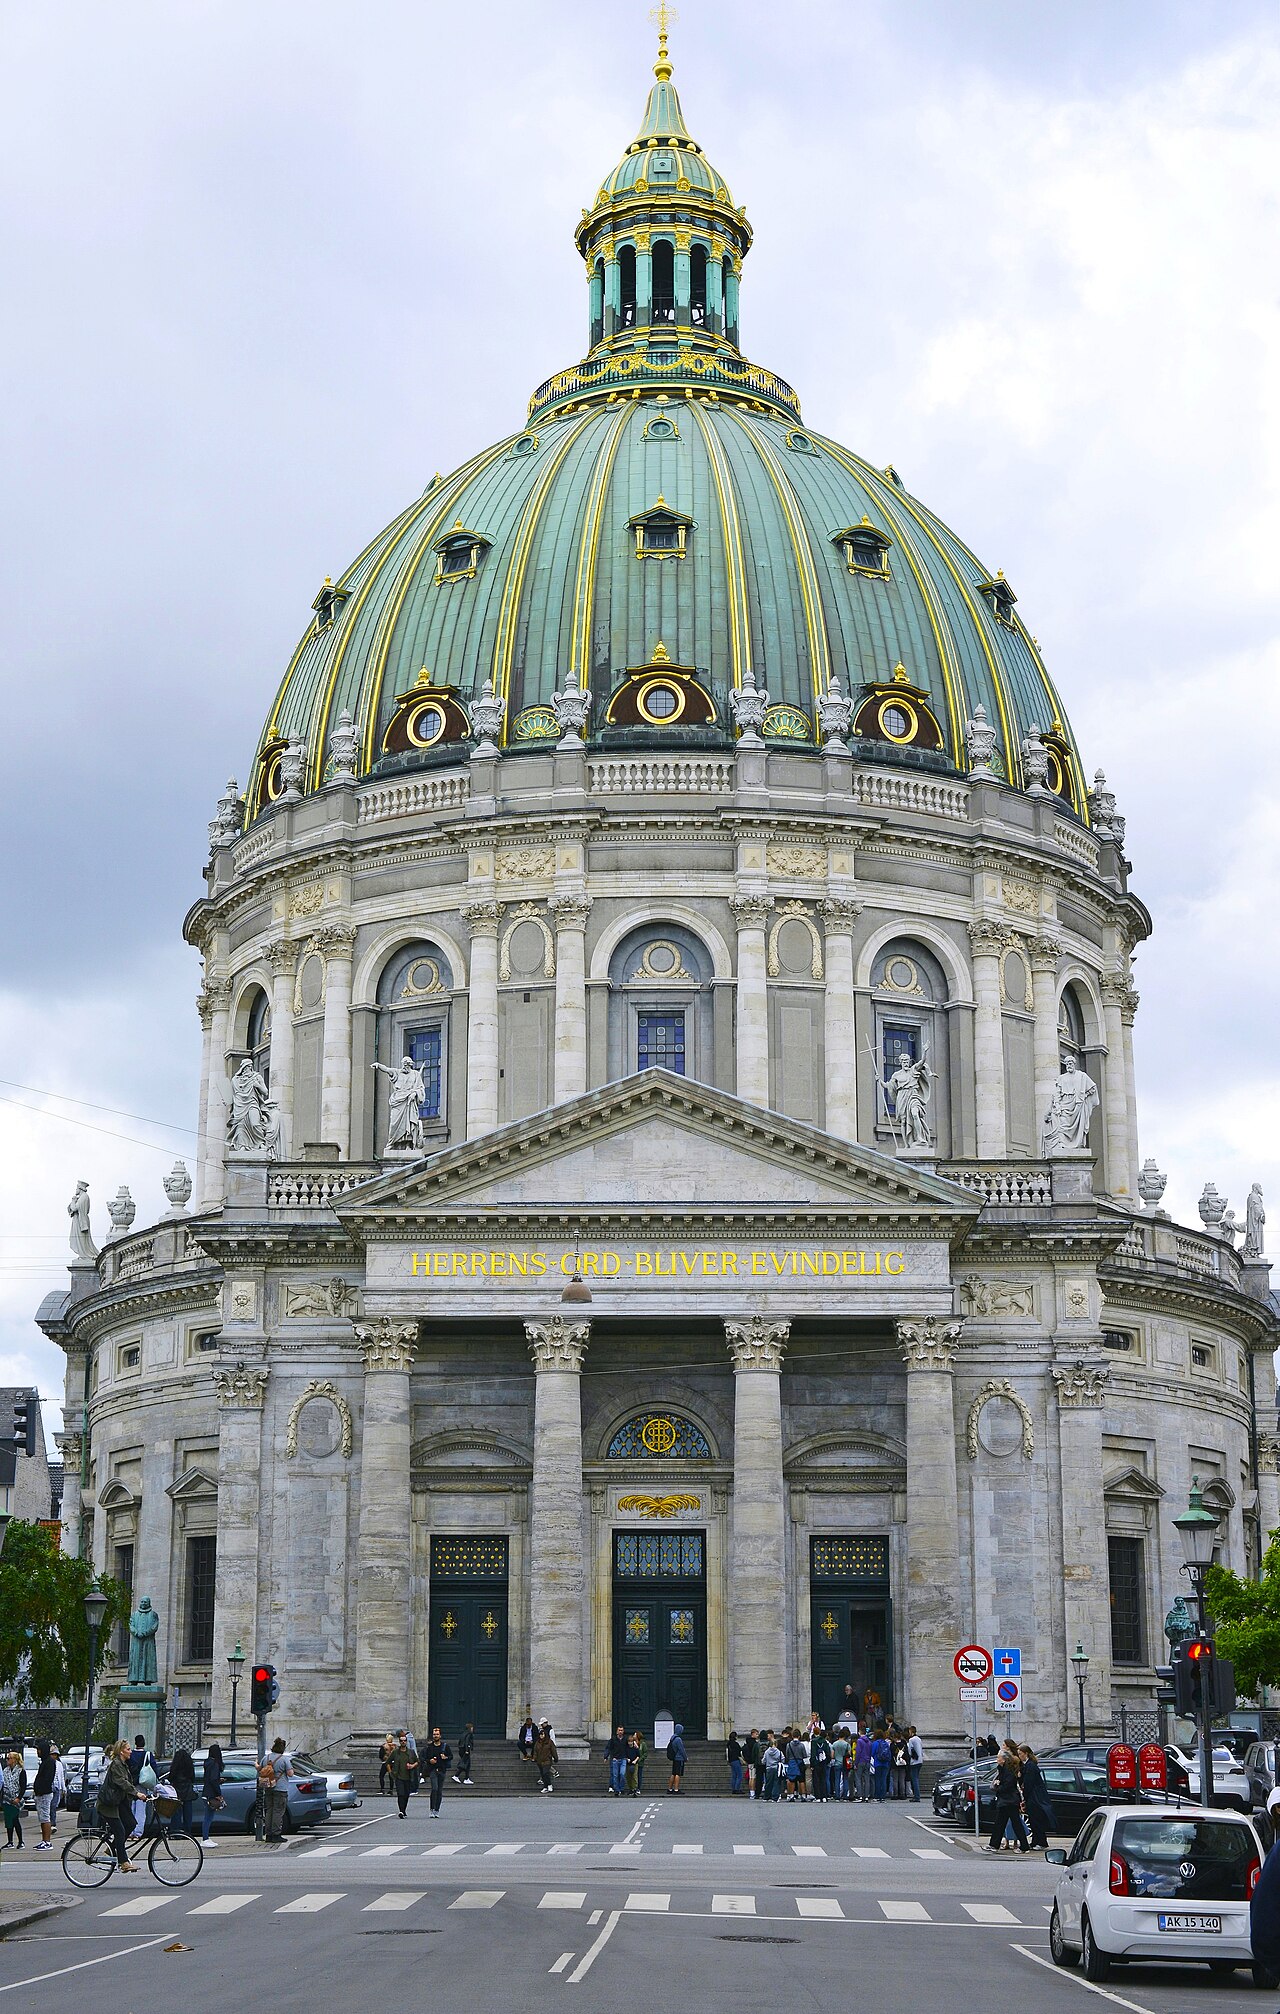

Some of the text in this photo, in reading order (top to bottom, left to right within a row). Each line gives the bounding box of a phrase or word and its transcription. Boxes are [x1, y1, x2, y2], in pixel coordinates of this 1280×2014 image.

[411, 1251, 906, 1276] HERRENS ORD BLIVER EVINDELIG
[1167, 1916, 1182, 1927] AK
[1184, 1917, 1197, 1928] 15
[1199, 1917, 1219, 1929] 140
